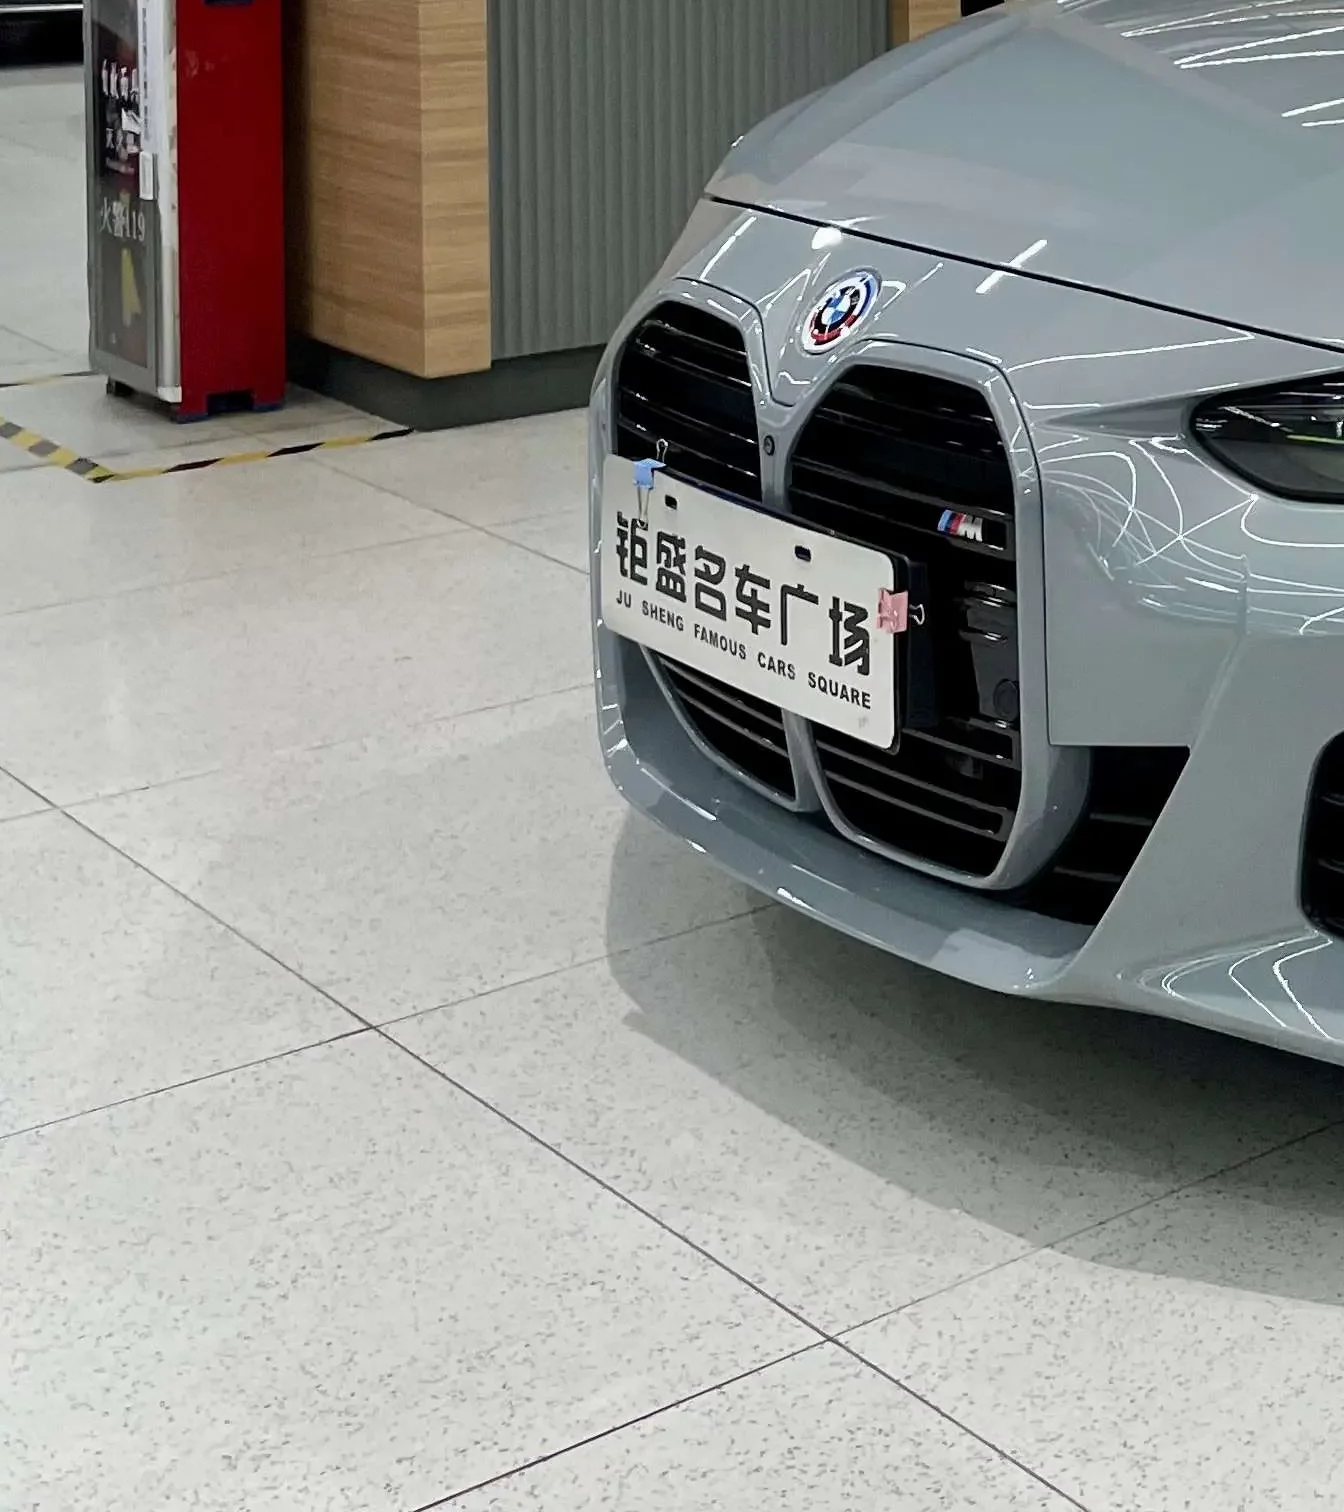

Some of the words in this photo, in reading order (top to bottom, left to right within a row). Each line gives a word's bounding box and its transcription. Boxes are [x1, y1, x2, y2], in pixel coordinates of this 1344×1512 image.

[616, 511, 870, 676] 钜盛名车广场
[616, 589, 632, 608] JU
[641, 601, 685, 632] SHENG
[693, 623, 747, 661] FAMOUS
[757, 652, 796, 680] CARS
[807, 671, 871, 710] SQUARE
